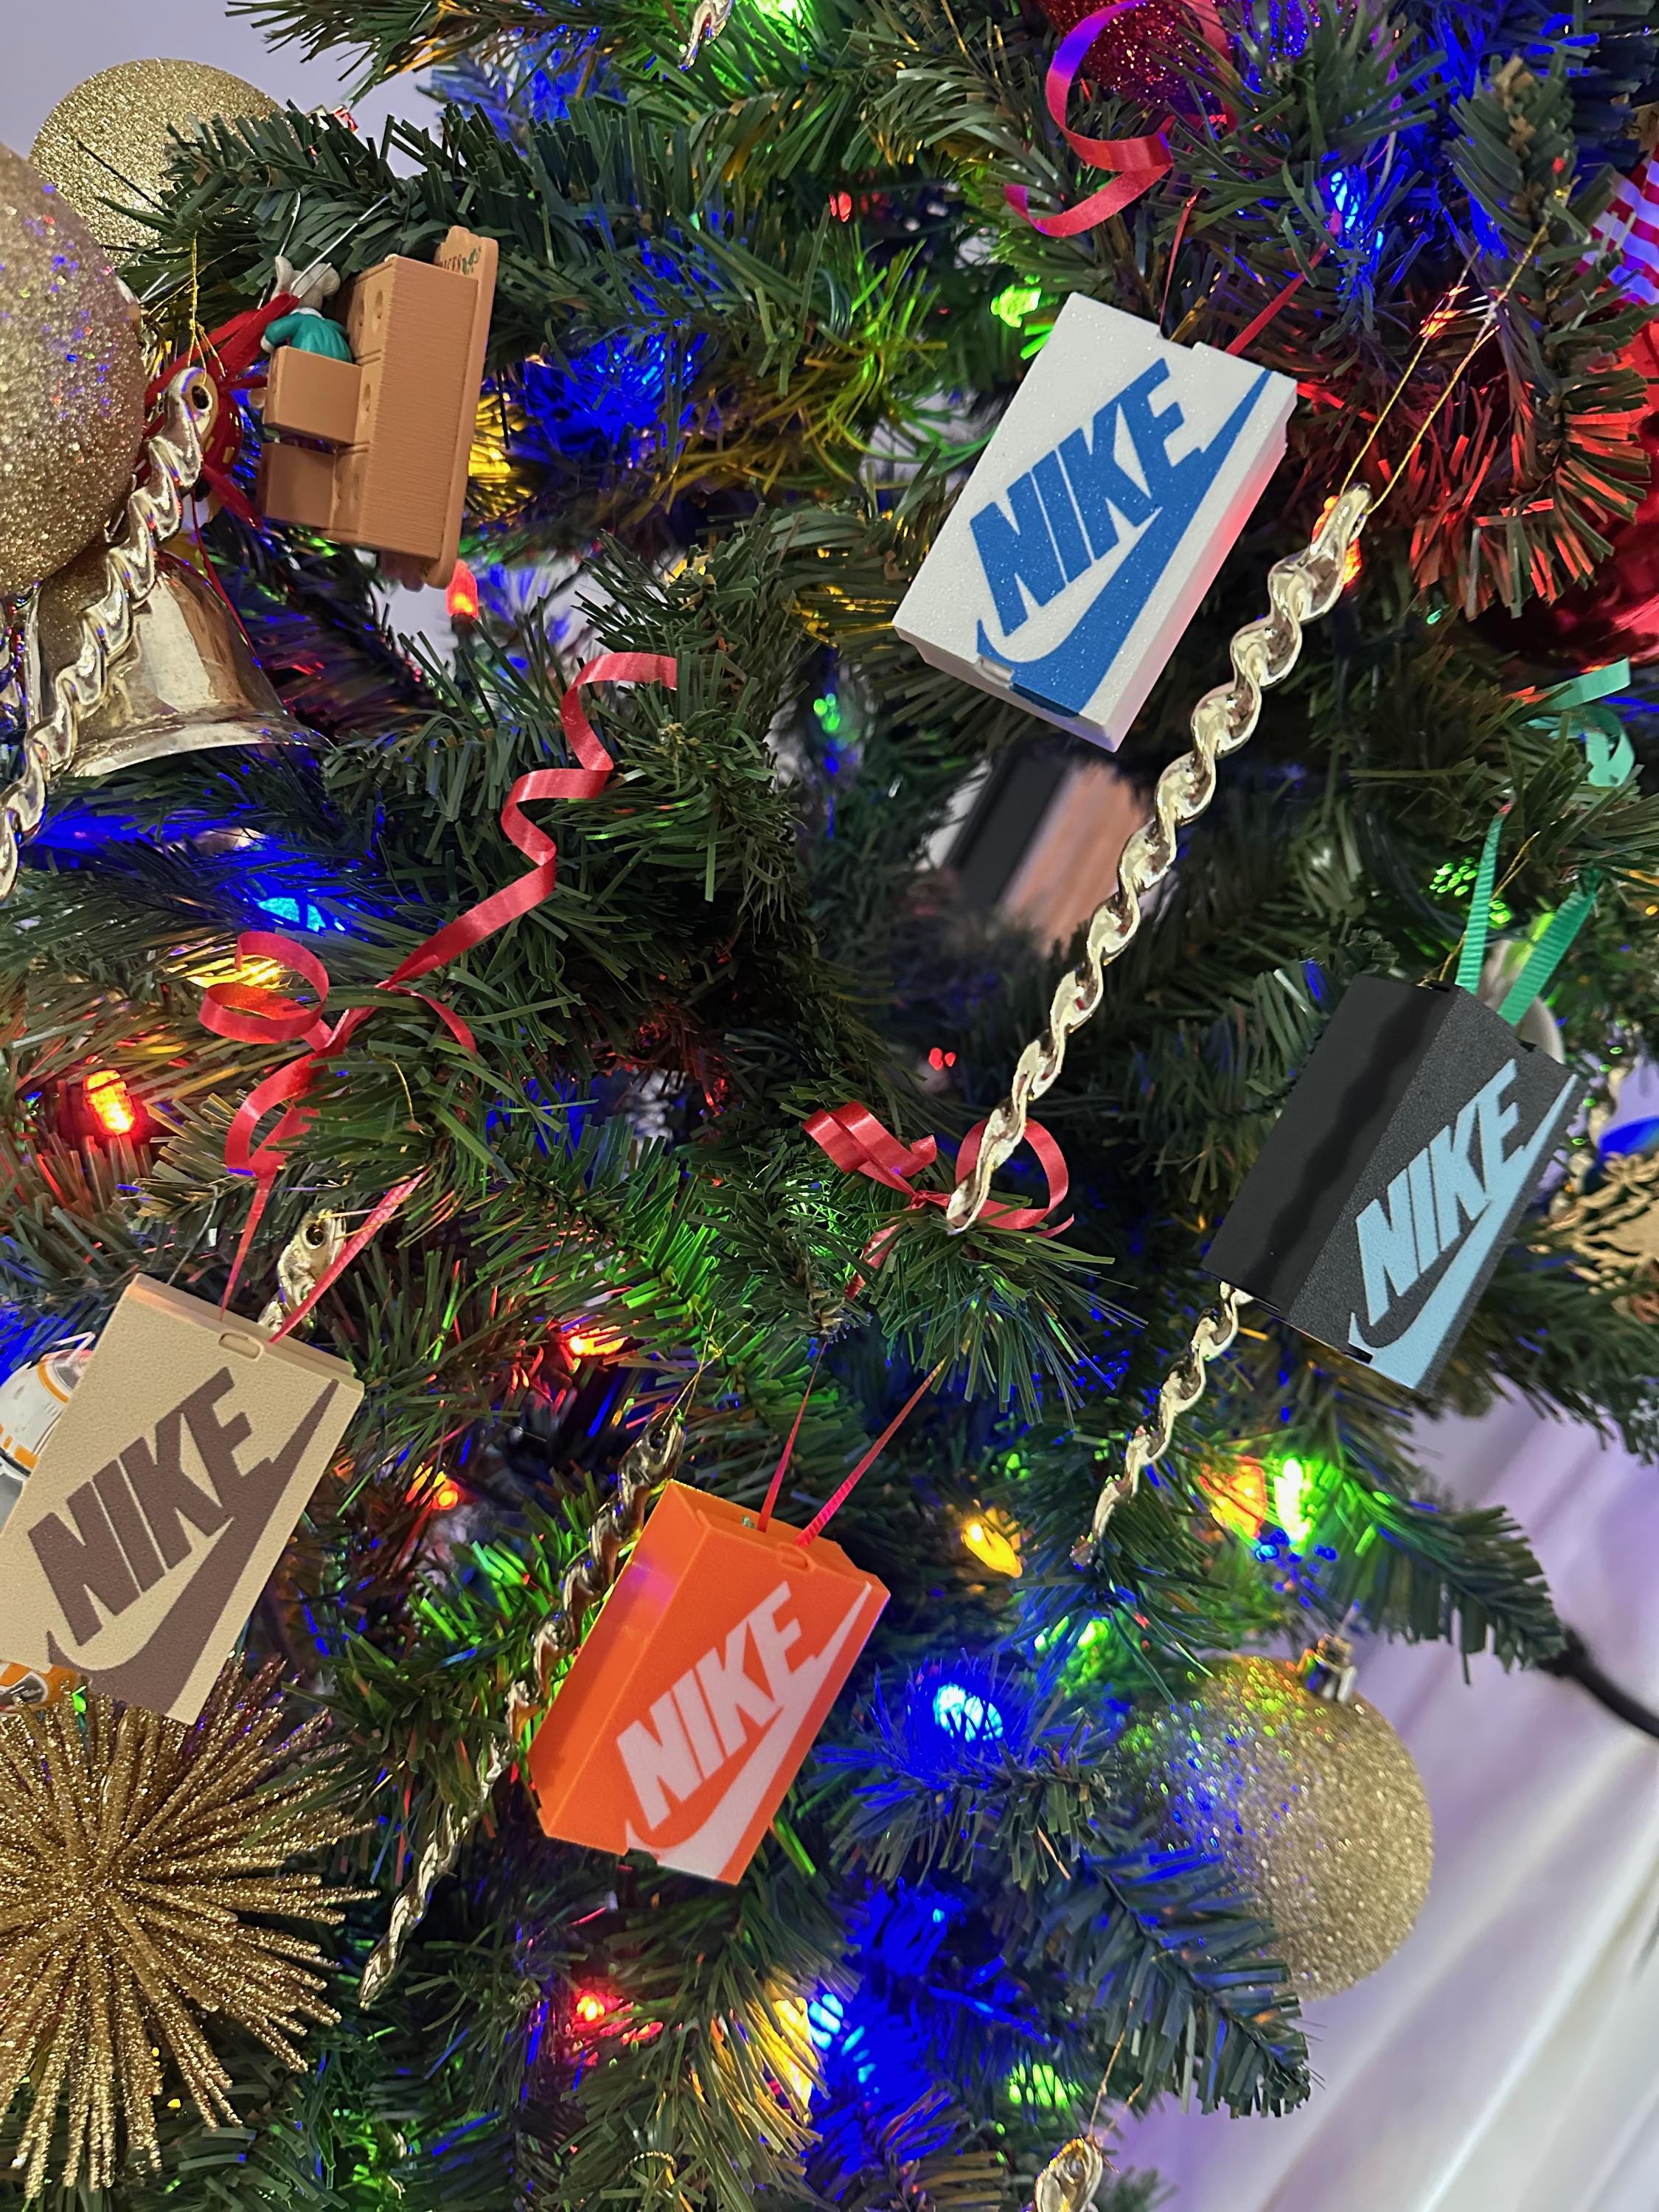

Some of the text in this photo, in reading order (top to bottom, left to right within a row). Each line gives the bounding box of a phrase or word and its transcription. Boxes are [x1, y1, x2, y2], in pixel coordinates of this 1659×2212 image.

[970, 358, 1203, 637] NIKE
[1356, 1059, 1525, 1326] NIKE
[28, 1366, 273, 1646] NIKE
[616, 1581, 816, 1830] NIKE
